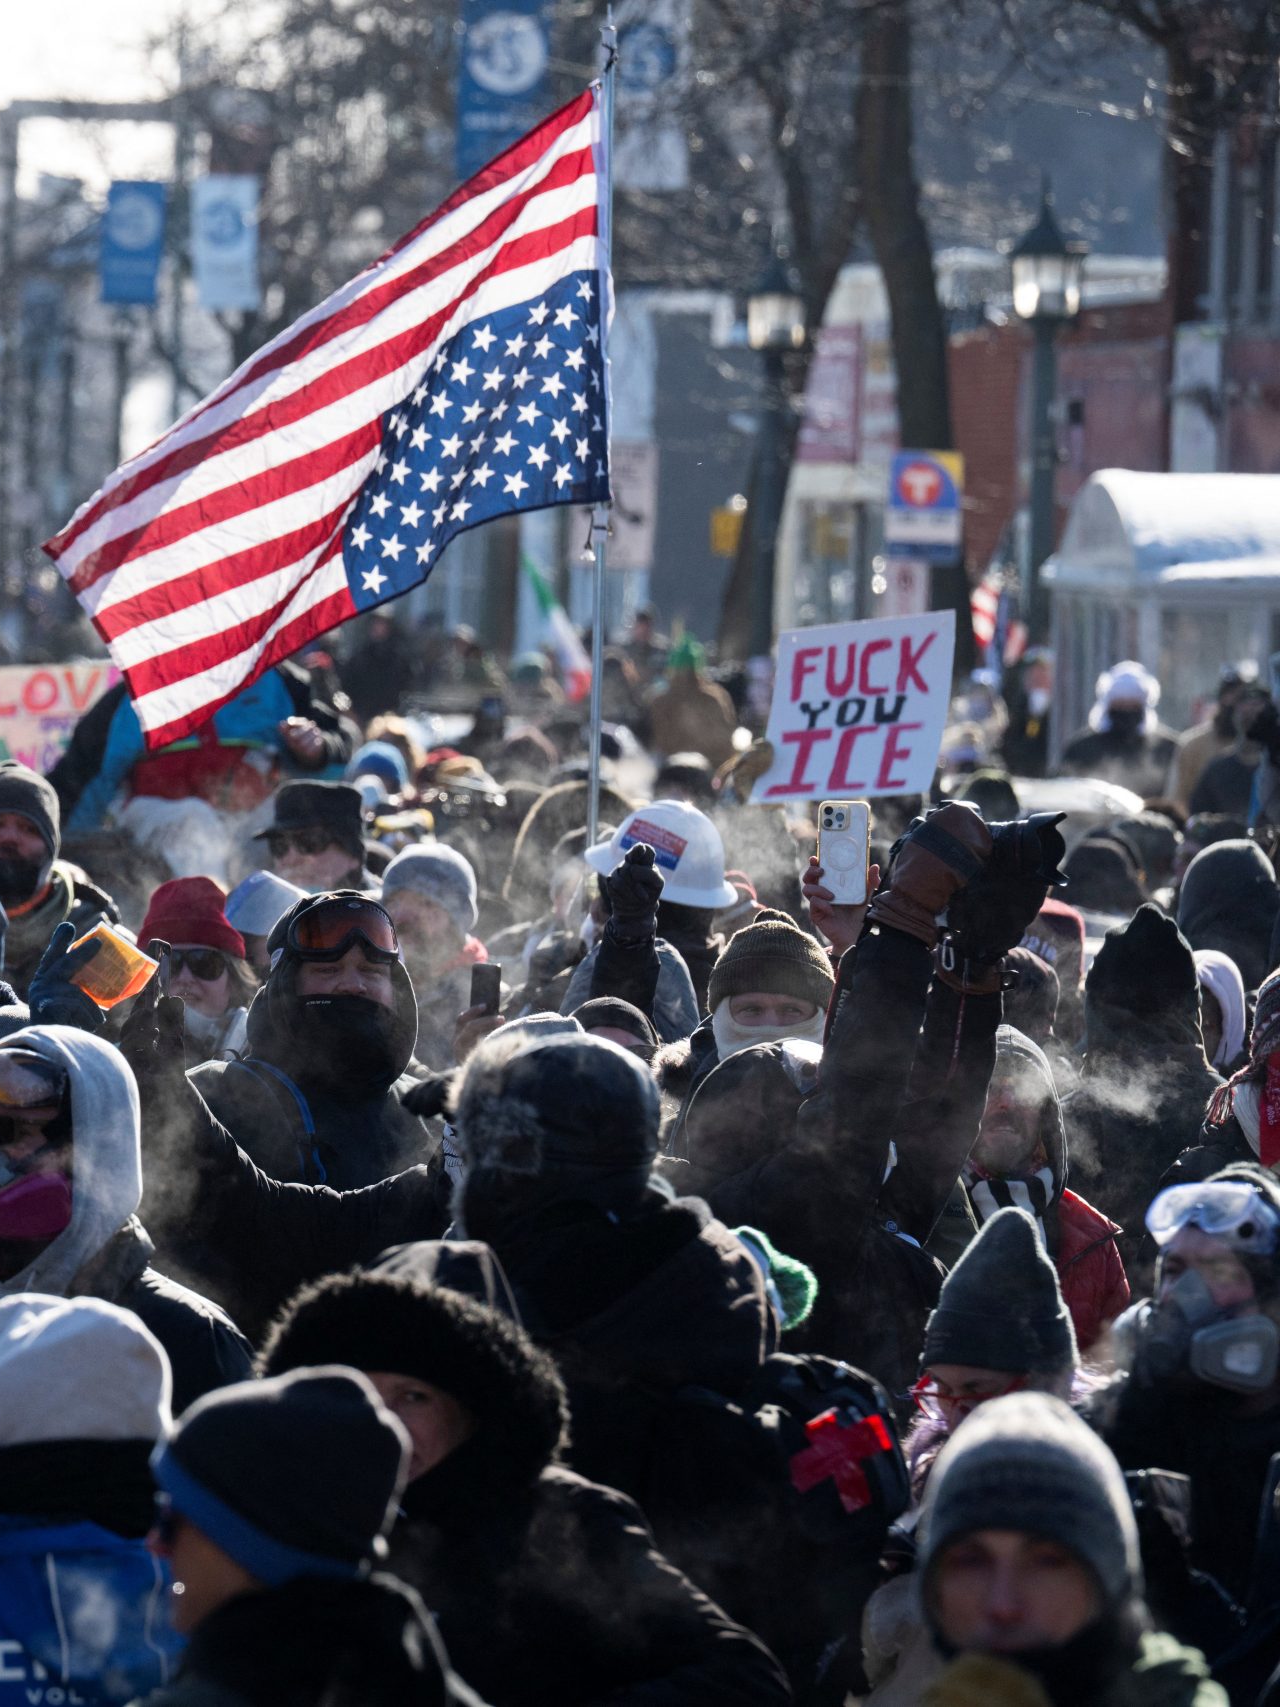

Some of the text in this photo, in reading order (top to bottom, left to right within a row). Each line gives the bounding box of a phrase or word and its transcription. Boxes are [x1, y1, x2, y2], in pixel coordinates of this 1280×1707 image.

[790, 631, 938, 703] FUCK
[799, 695, 907, 730] YOU
[764, 722, 924, 797] ICE
